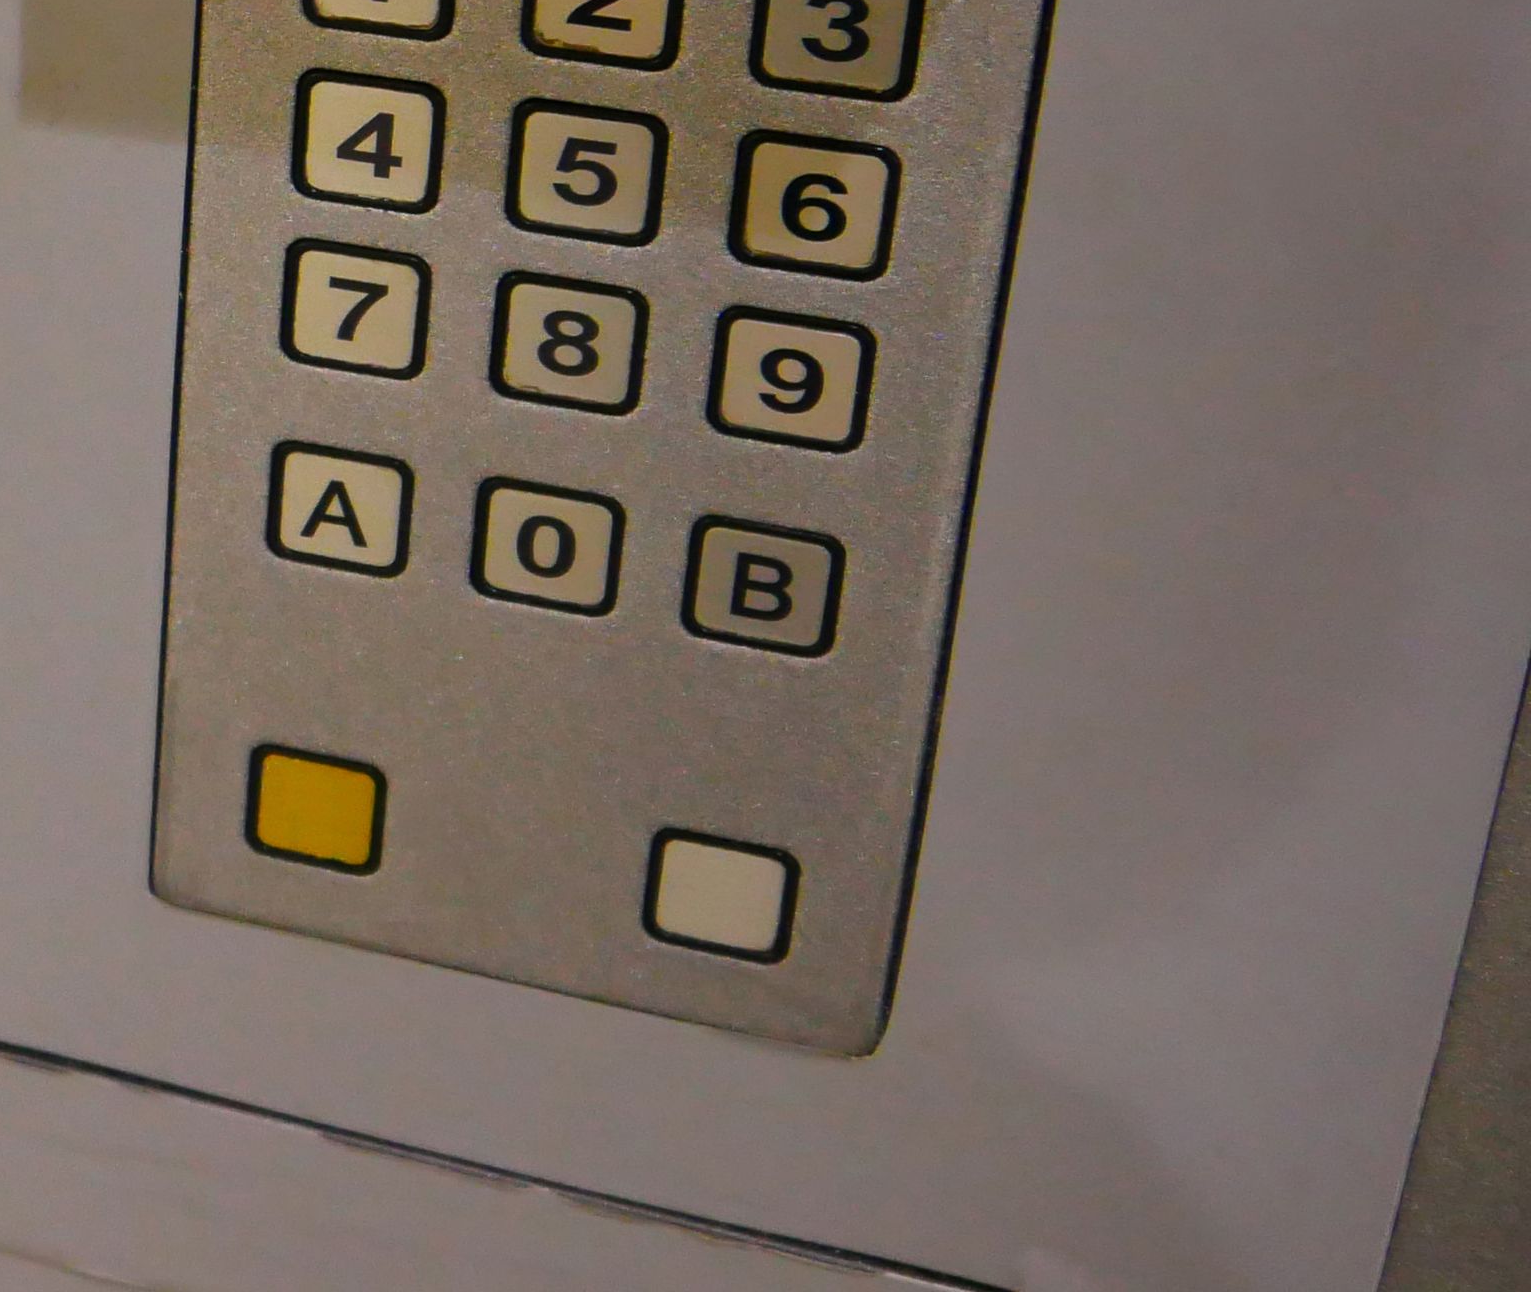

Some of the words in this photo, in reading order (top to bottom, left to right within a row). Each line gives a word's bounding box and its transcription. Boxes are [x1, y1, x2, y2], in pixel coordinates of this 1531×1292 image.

[336, 113, 402, 178] 4
[552, 138, 618, 206] 5
[780, 173, 848, 242] 6
[328, 277, 388, 341] 7
[537, 310, 599, 376] 8
[758, 348, 824, 414] 9
[300, 480, 367, 547] A
[516, 515, 576, 578] 0
[729, 551, 795, 622] B
